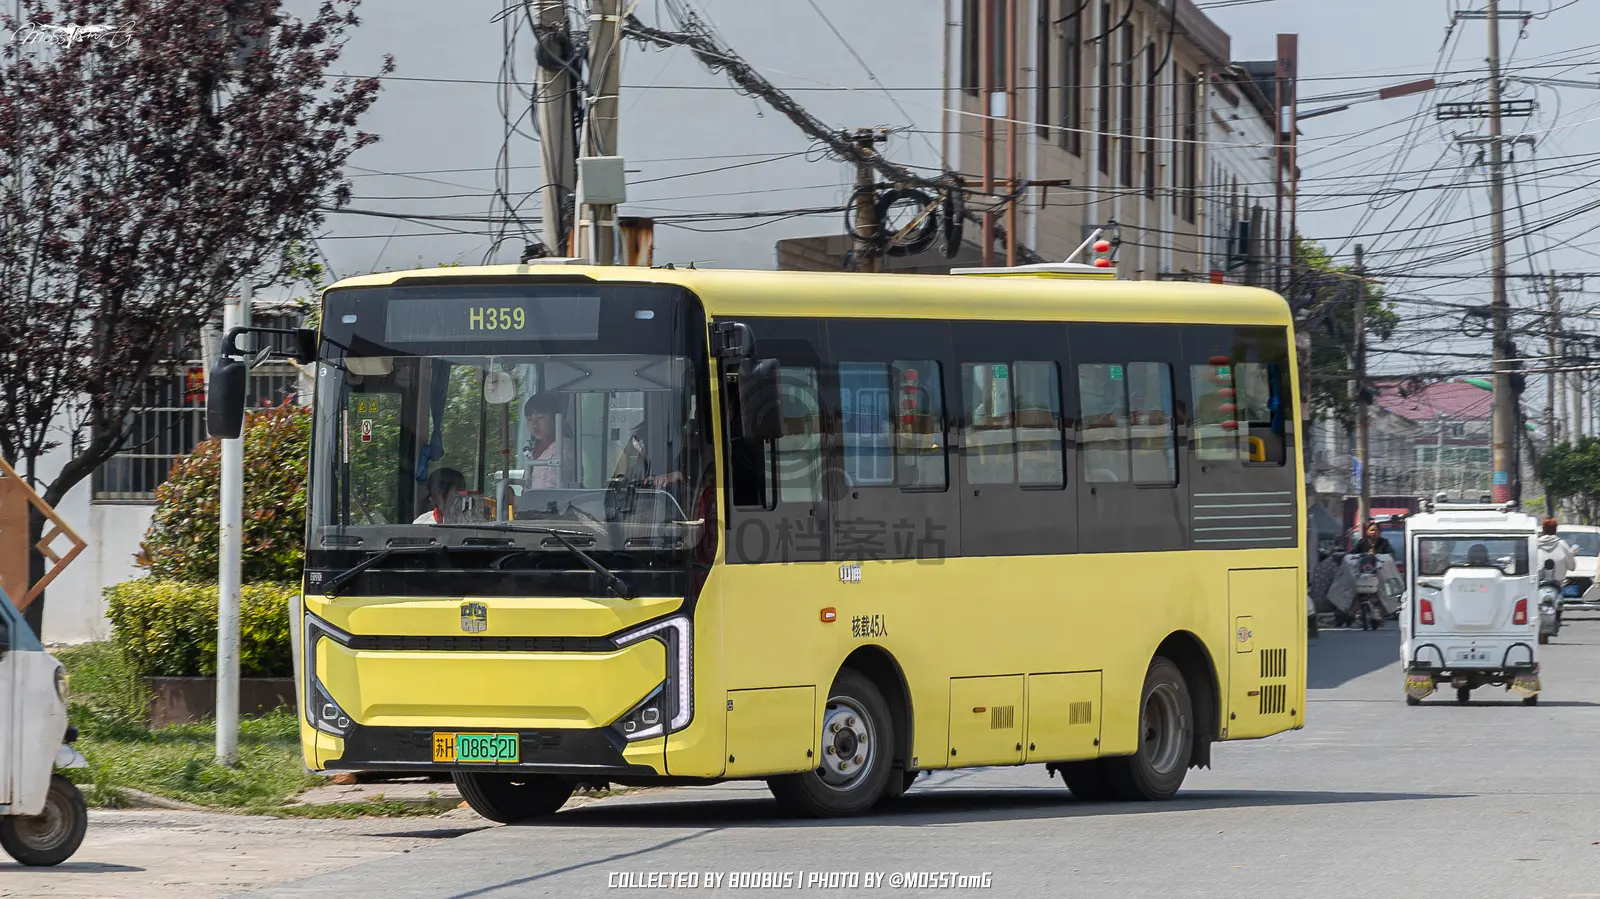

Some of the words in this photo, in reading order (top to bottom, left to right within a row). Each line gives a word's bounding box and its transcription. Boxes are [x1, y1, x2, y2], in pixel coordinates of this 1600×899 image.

[469, 307, 525, 330] H359
[852, 614, 888, 638] 核载45人
